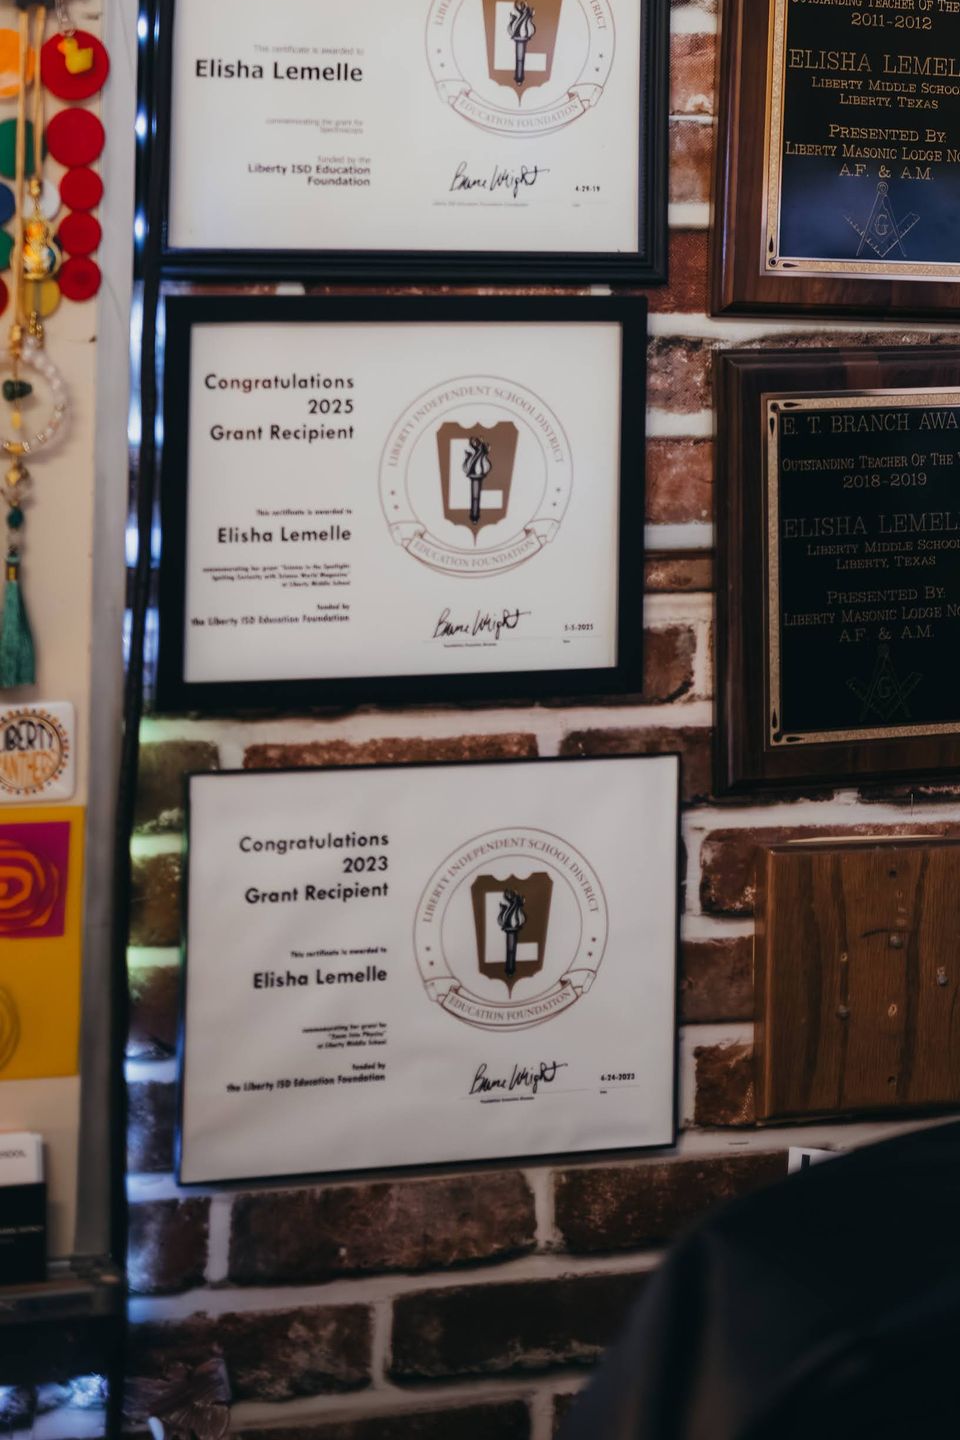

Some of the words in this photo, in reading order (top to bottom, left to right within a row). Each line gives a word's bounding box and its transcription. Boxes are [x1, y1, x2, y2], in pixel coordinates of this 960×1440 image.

[851, 12, 932, 30] 2011-2012
[196, 59, 263, 78] Elisha
[274, 62, 362, 81] Lemelle
[789, 48, 872, 72] ELISHA
[204, 373, 354, 393] Congratulations
[308, 399, 353, 414] 2025
[830, 413, 910, 433] BRANCH
[210, 425, 263, 441] Grant
[270, 424, 354, 443] Recipient
[843, 472, 927, 488] 2018-2019
[218, 527, 273, 543] Elisha
[281, 526, 351, 542] Lemelle
[783, 516, 868, 538] ELISHA
[239, 832, 389, 855] Congratulations
[343, 855, 388, 873] 2023
[245, 887, 298, 904] Grant
[305, 882, 388, 902] Recipient
[253, 971, 308, 989] Elisha
[316, 966, 387, 985] Lemelle
